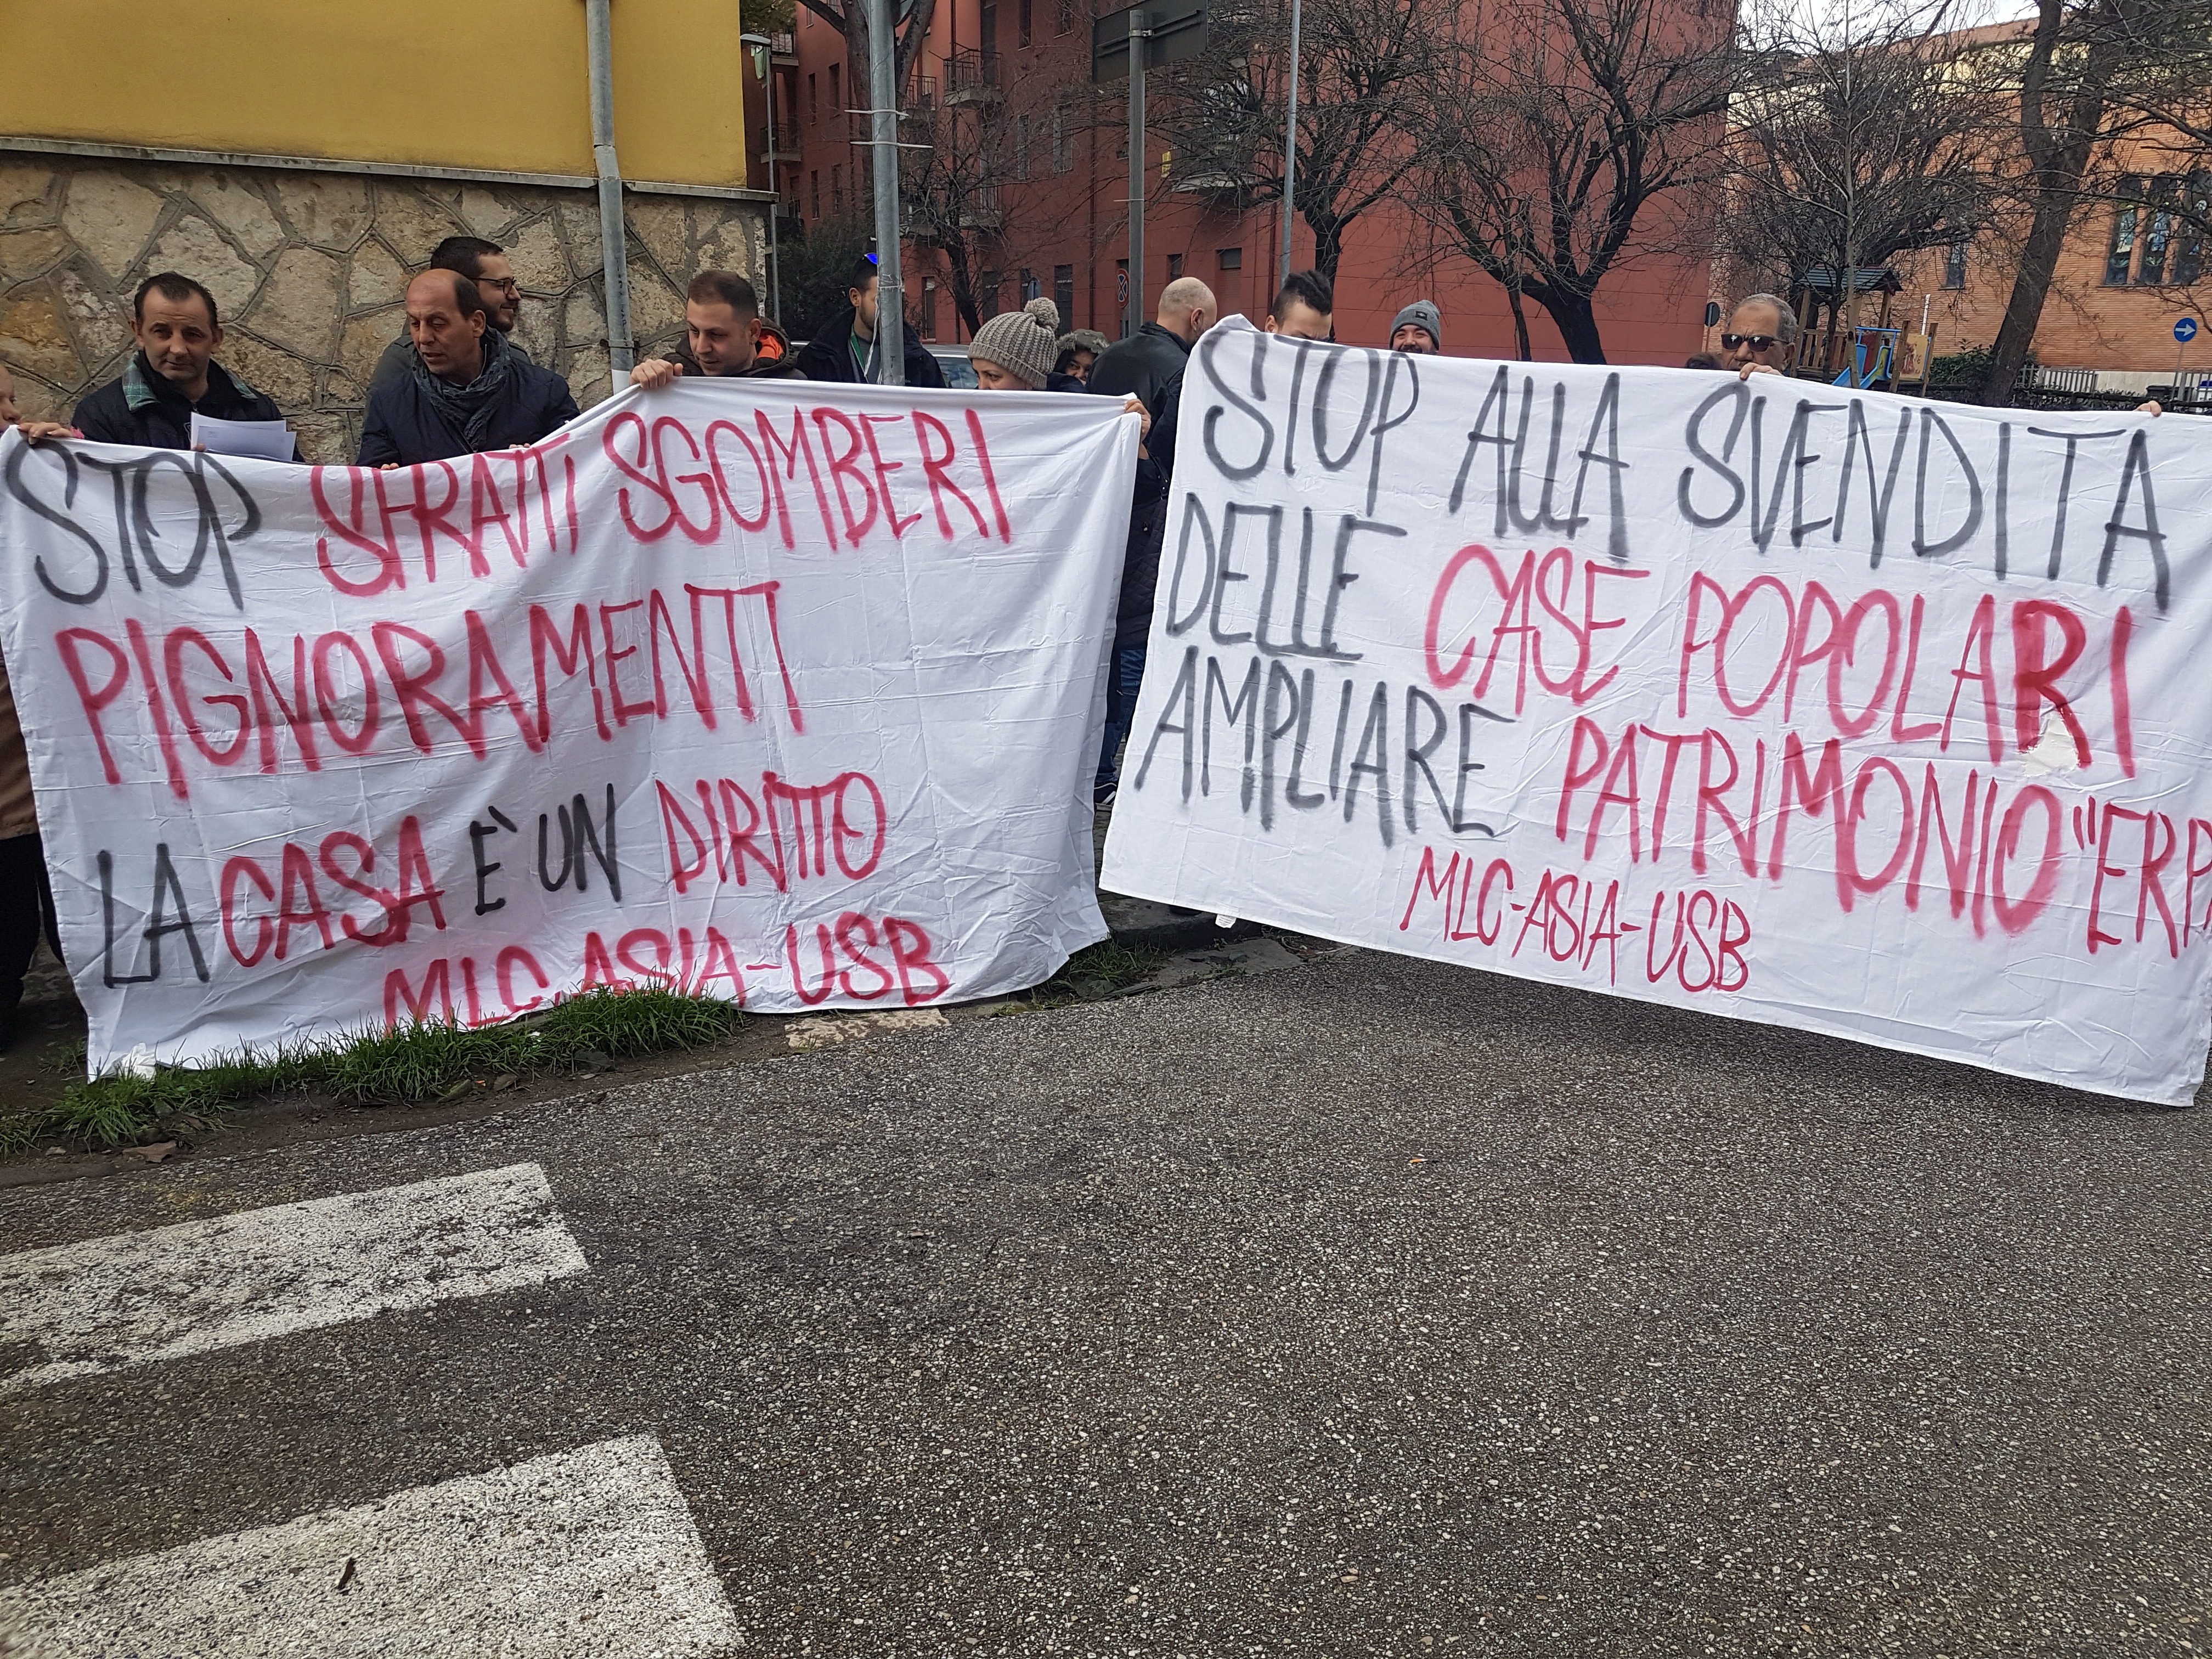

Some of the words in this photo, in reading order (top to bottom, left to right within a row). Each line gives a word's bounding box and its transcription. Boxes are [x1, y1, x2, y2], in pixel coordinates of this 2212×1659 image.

[4, 439, 261, 611] STOP
[602, 405, 1010, 551] SGOMBERI
[1200, 328, 1420, 517] STOP
[1448, 364, 1630, 562] ALLA
[1678, 380, 2171, 614] SVENDITA
[55, 579, 806, 801] PIGNORAMENTI
[1165, 492, 1408, 662] DELLE
[1424, 543, 1650, 715] CASE
[1678, 571, 2136, 778] POPOLARI
[97, 842, 210, 988] LA
[220, 815, 446, 968] CASA
[538, 782, 622, 903] UN
[654, 770, 887, 894] DIRITTO
[1133, 645, 1520, 848] AMPLIARE
[1555, 715, 2064, 939] PATRIMONIO
[2073, 795, 2212, 960] "ERP
[1399, 846, 1751, 992] MLC-ASIA-USB
